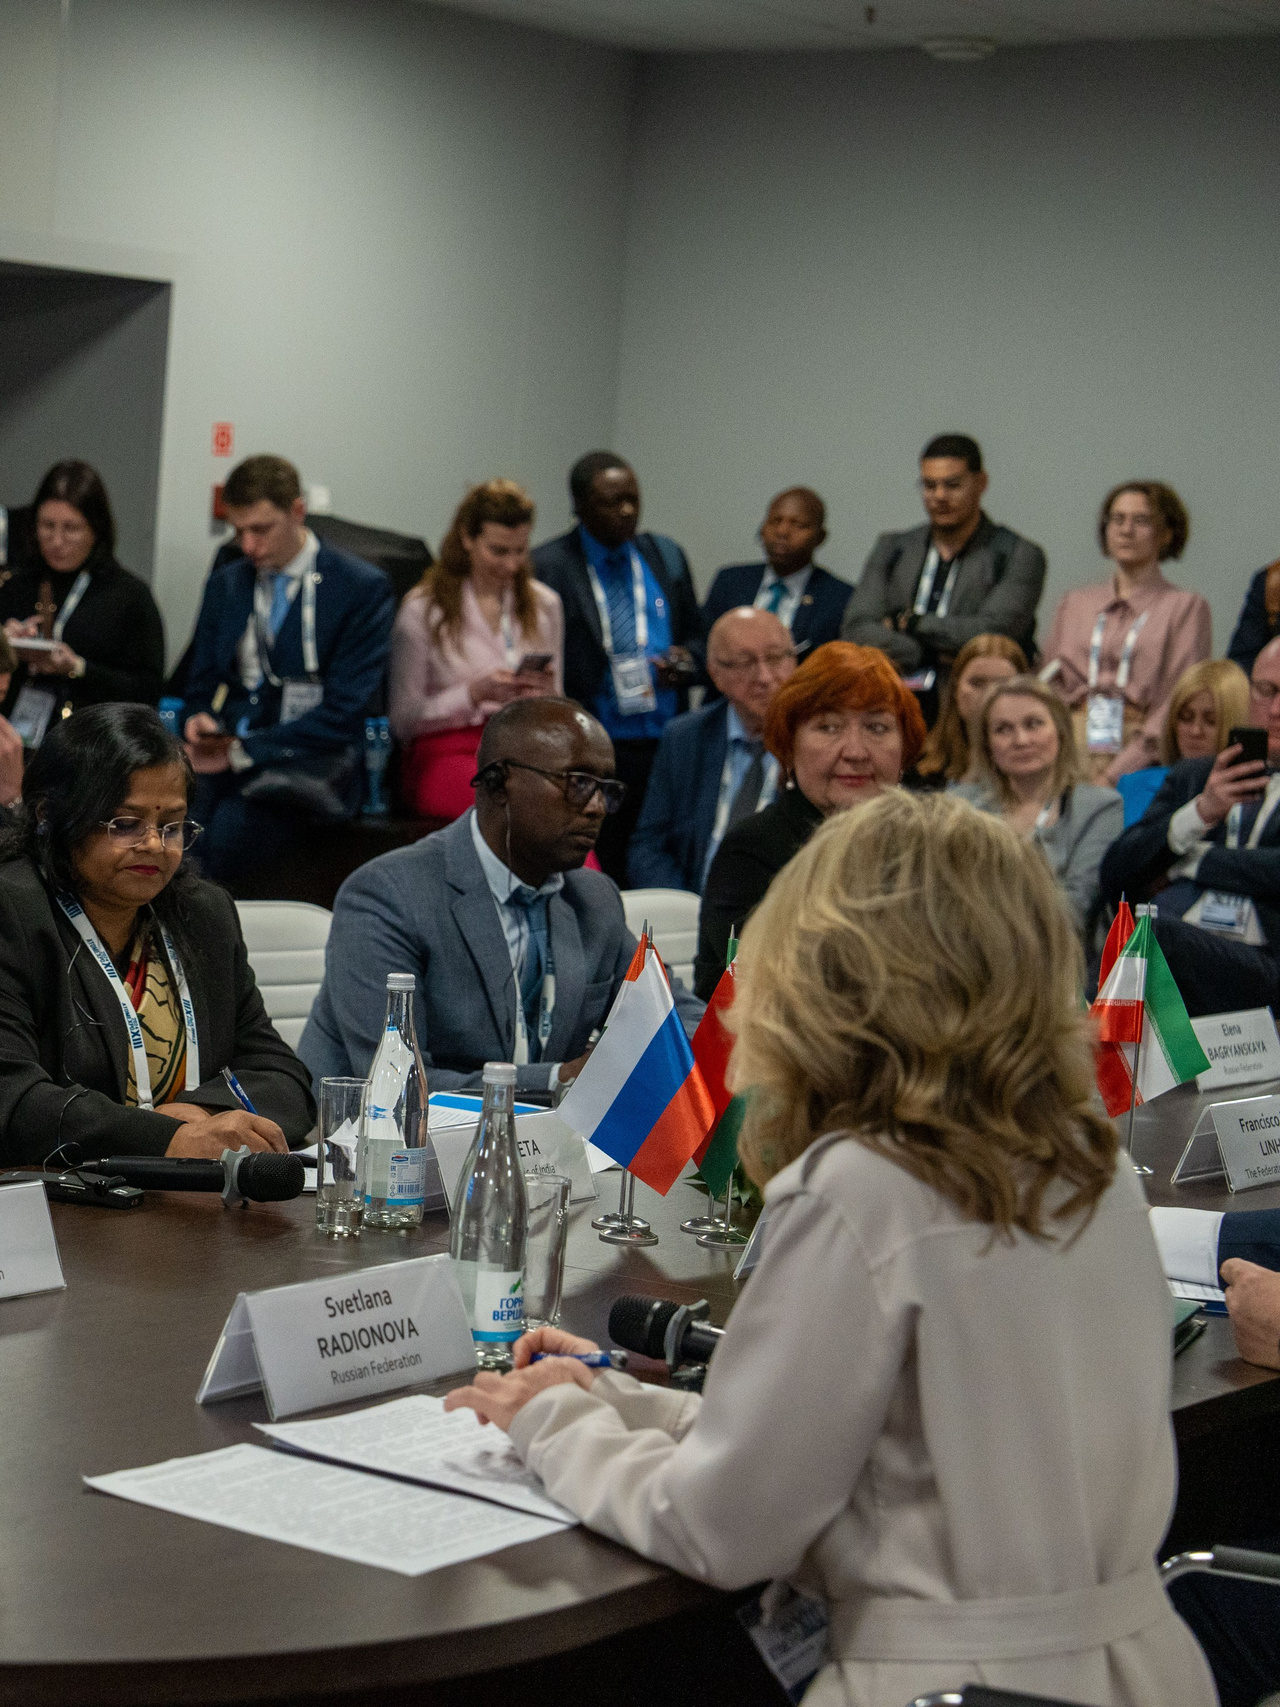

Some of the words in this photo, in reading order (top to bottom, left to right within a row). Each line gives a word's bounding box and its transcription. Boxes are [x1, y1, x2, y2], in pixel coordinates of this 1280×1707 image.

[121, 1002, 136, 1032] ATOMEXPO
[130, 1030, 143, 1049] XIII
[1221, 1023, 1242, 1036] Elena
[1207, 1040, 1268, 1060] BAGRYANSKAYA
[1239, 1113, 1280, 1133] Francisco
[539, 1163, 556, 1174] India
[1245, 1167, 1258, 1179] The
[324, 1288, 392, 1318] Svetlana
[317, 1316, 420, 1359] RADIONOVA
[330, 1365, 370, 1385] Russian
[369, 1352, 423, 1376] Federation
